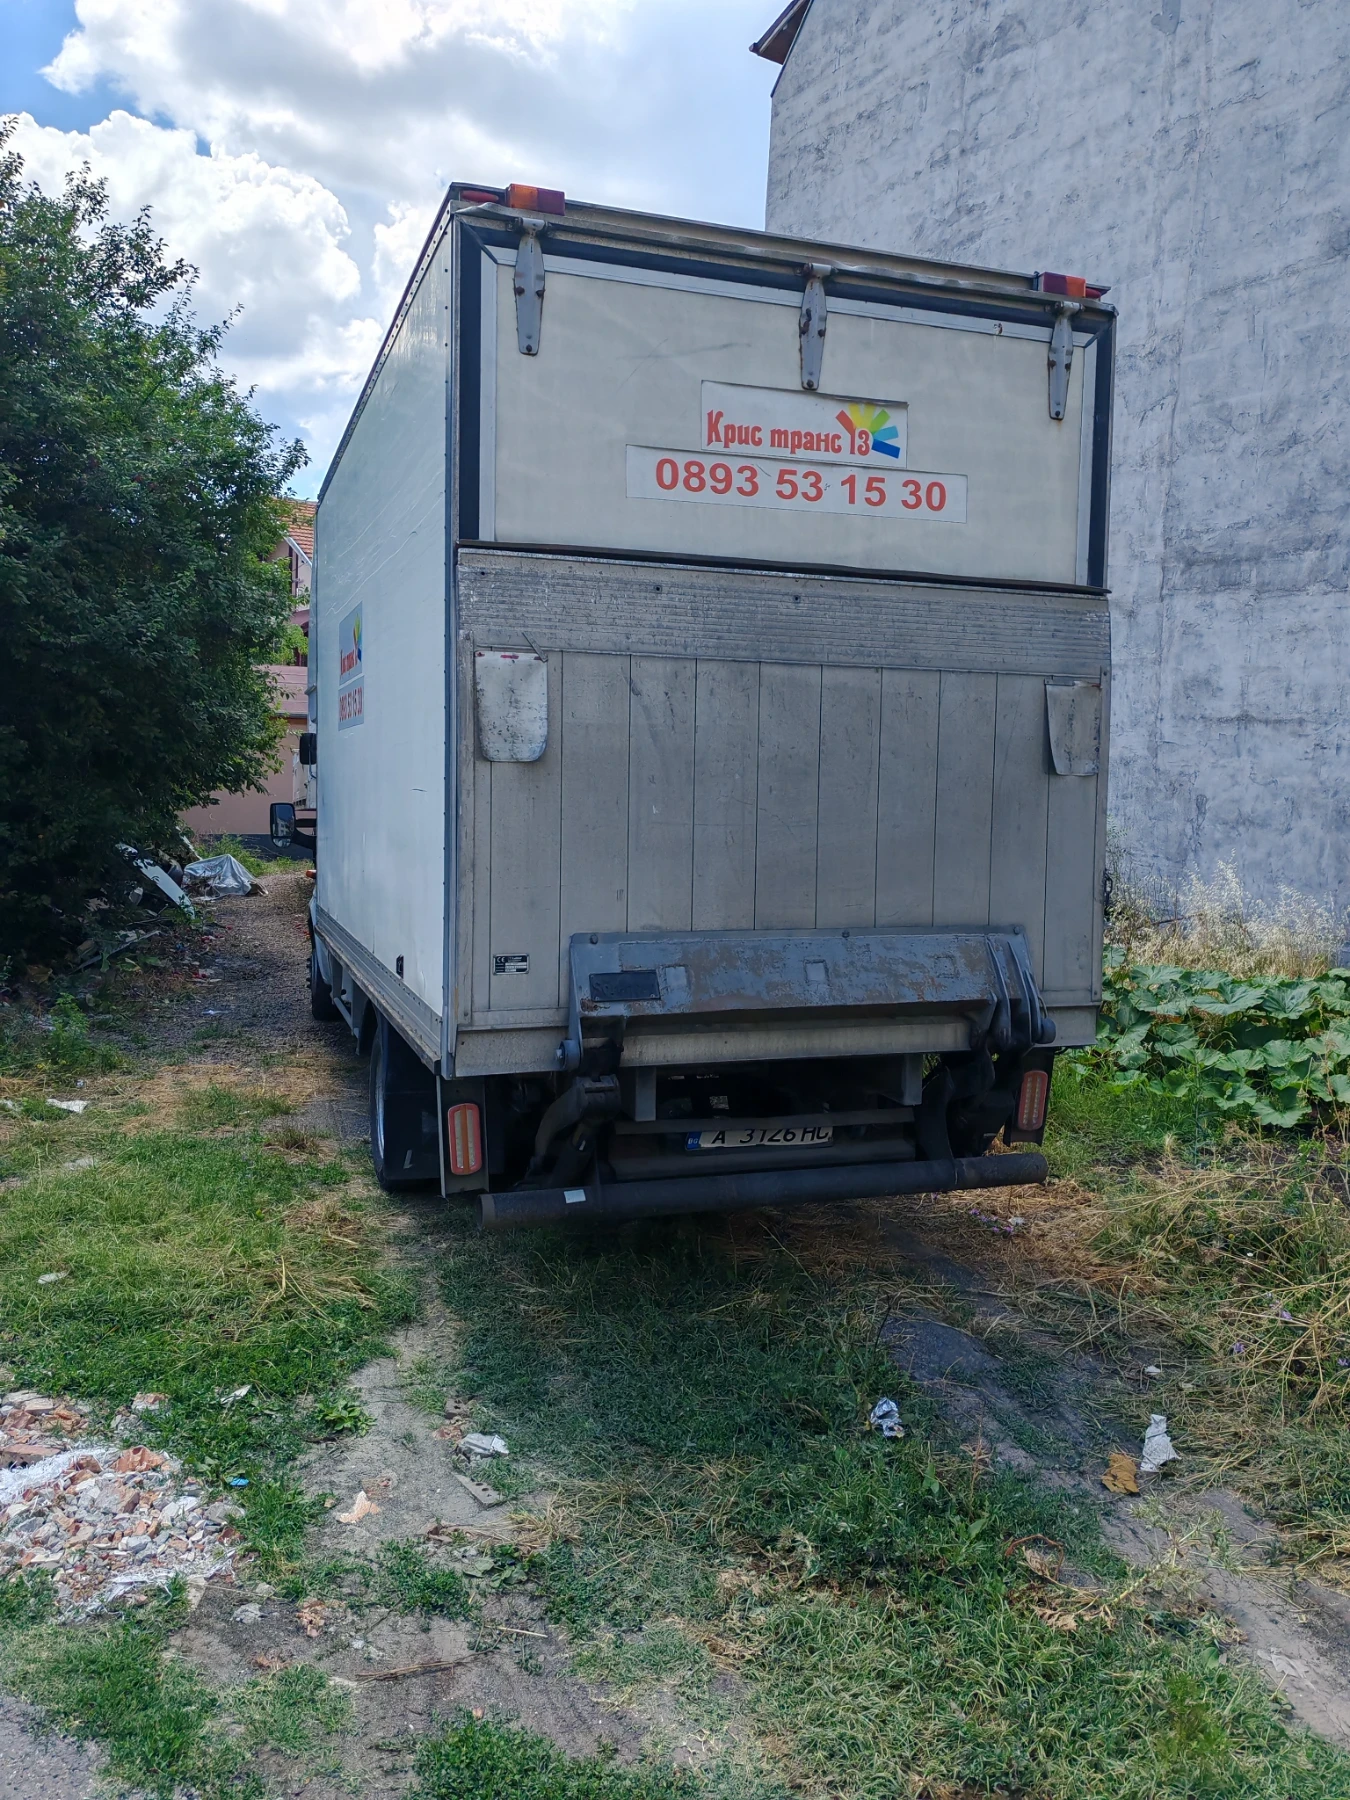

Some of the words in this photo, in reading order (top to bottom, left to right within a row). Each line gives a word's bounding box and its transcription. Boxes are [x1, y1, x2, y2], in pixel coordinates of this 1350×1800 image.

[706, 409, 763, 447] Крис
[770, 426, 842, 455] транс
[655, 458, 759, 497] 0893
[775, 469, 824, 502] 53
[840, 474, 887, 507] 15
[901, 479, 947, 512] 30
[711, 1130, 725, 1144] A
[739, 1128, 796, 1144] 3126
